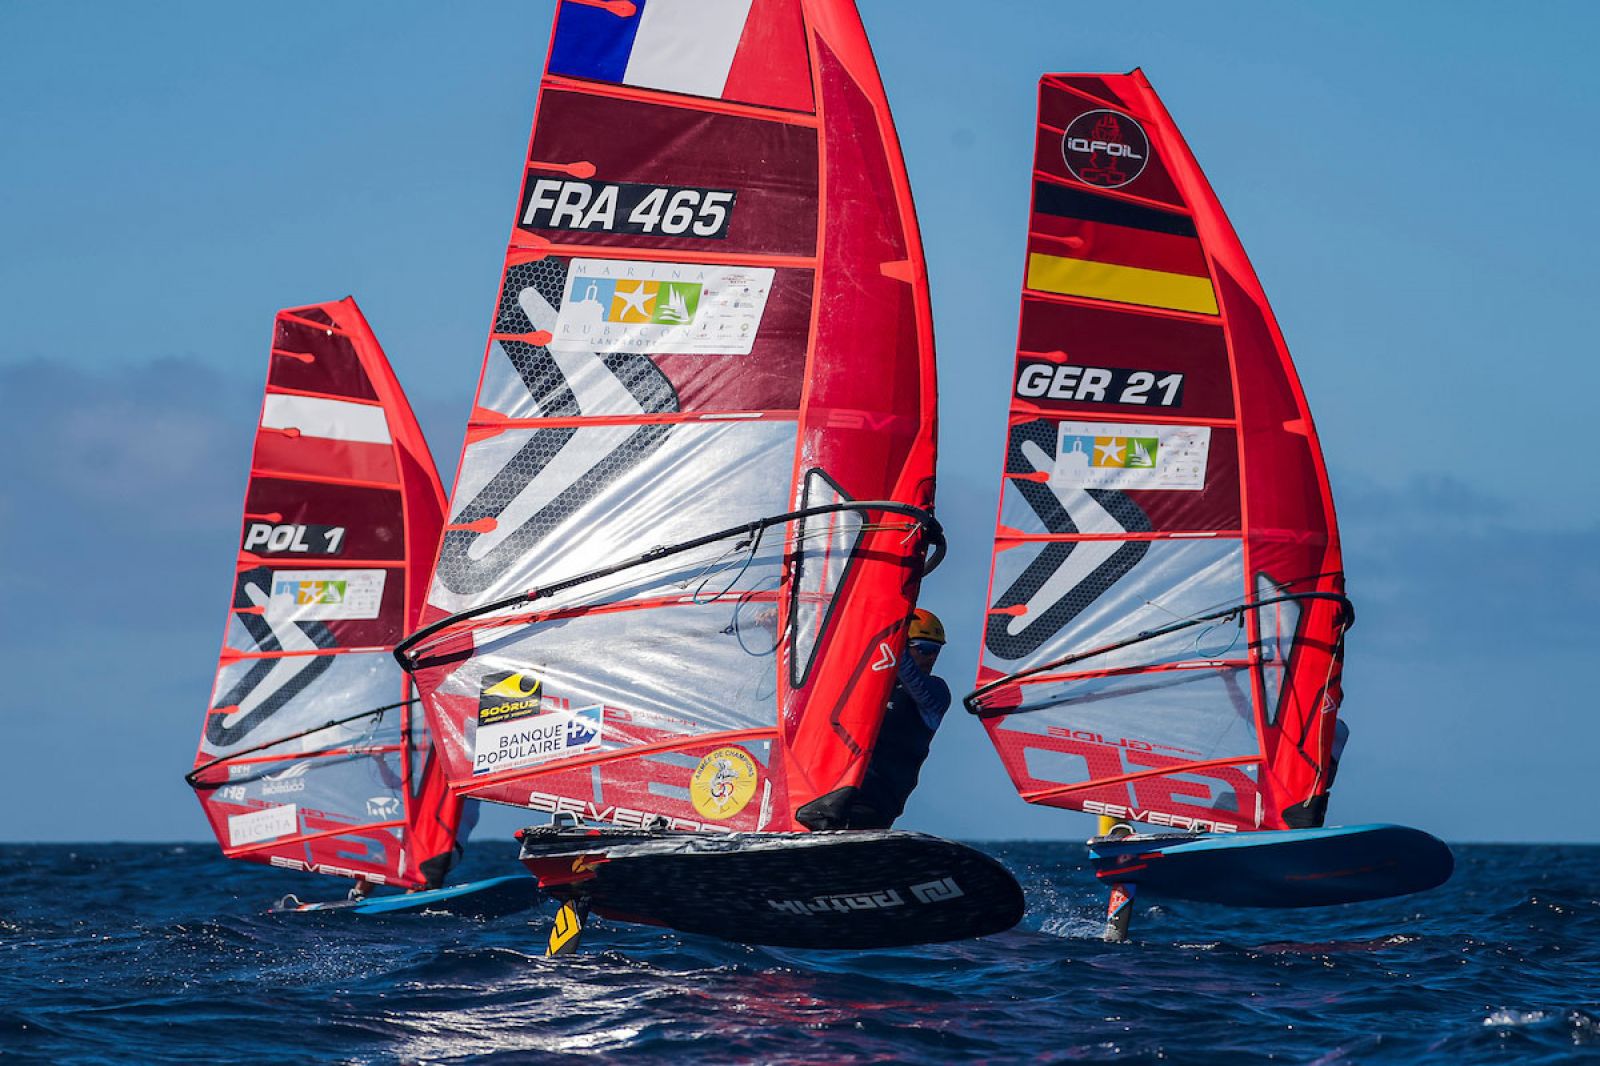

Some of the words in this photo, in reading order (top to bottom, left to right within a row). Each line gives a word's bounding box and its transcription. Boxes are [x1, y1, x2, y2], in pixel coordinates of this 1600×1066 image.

[522, 179, 620, 230] FRA
[627, 187, 733, 237] 465
[577, 264, 705, 280] MARINA
[1016, 364, 1113, 402] GER
[1119, 371, 1184, 406] 21
[243, 523, 309, 552] POL
[323, 527, 345, 554] 1
[499, 725, 563, 748] BANQUE
[477, 738, 562, 766] POPULAIRE
